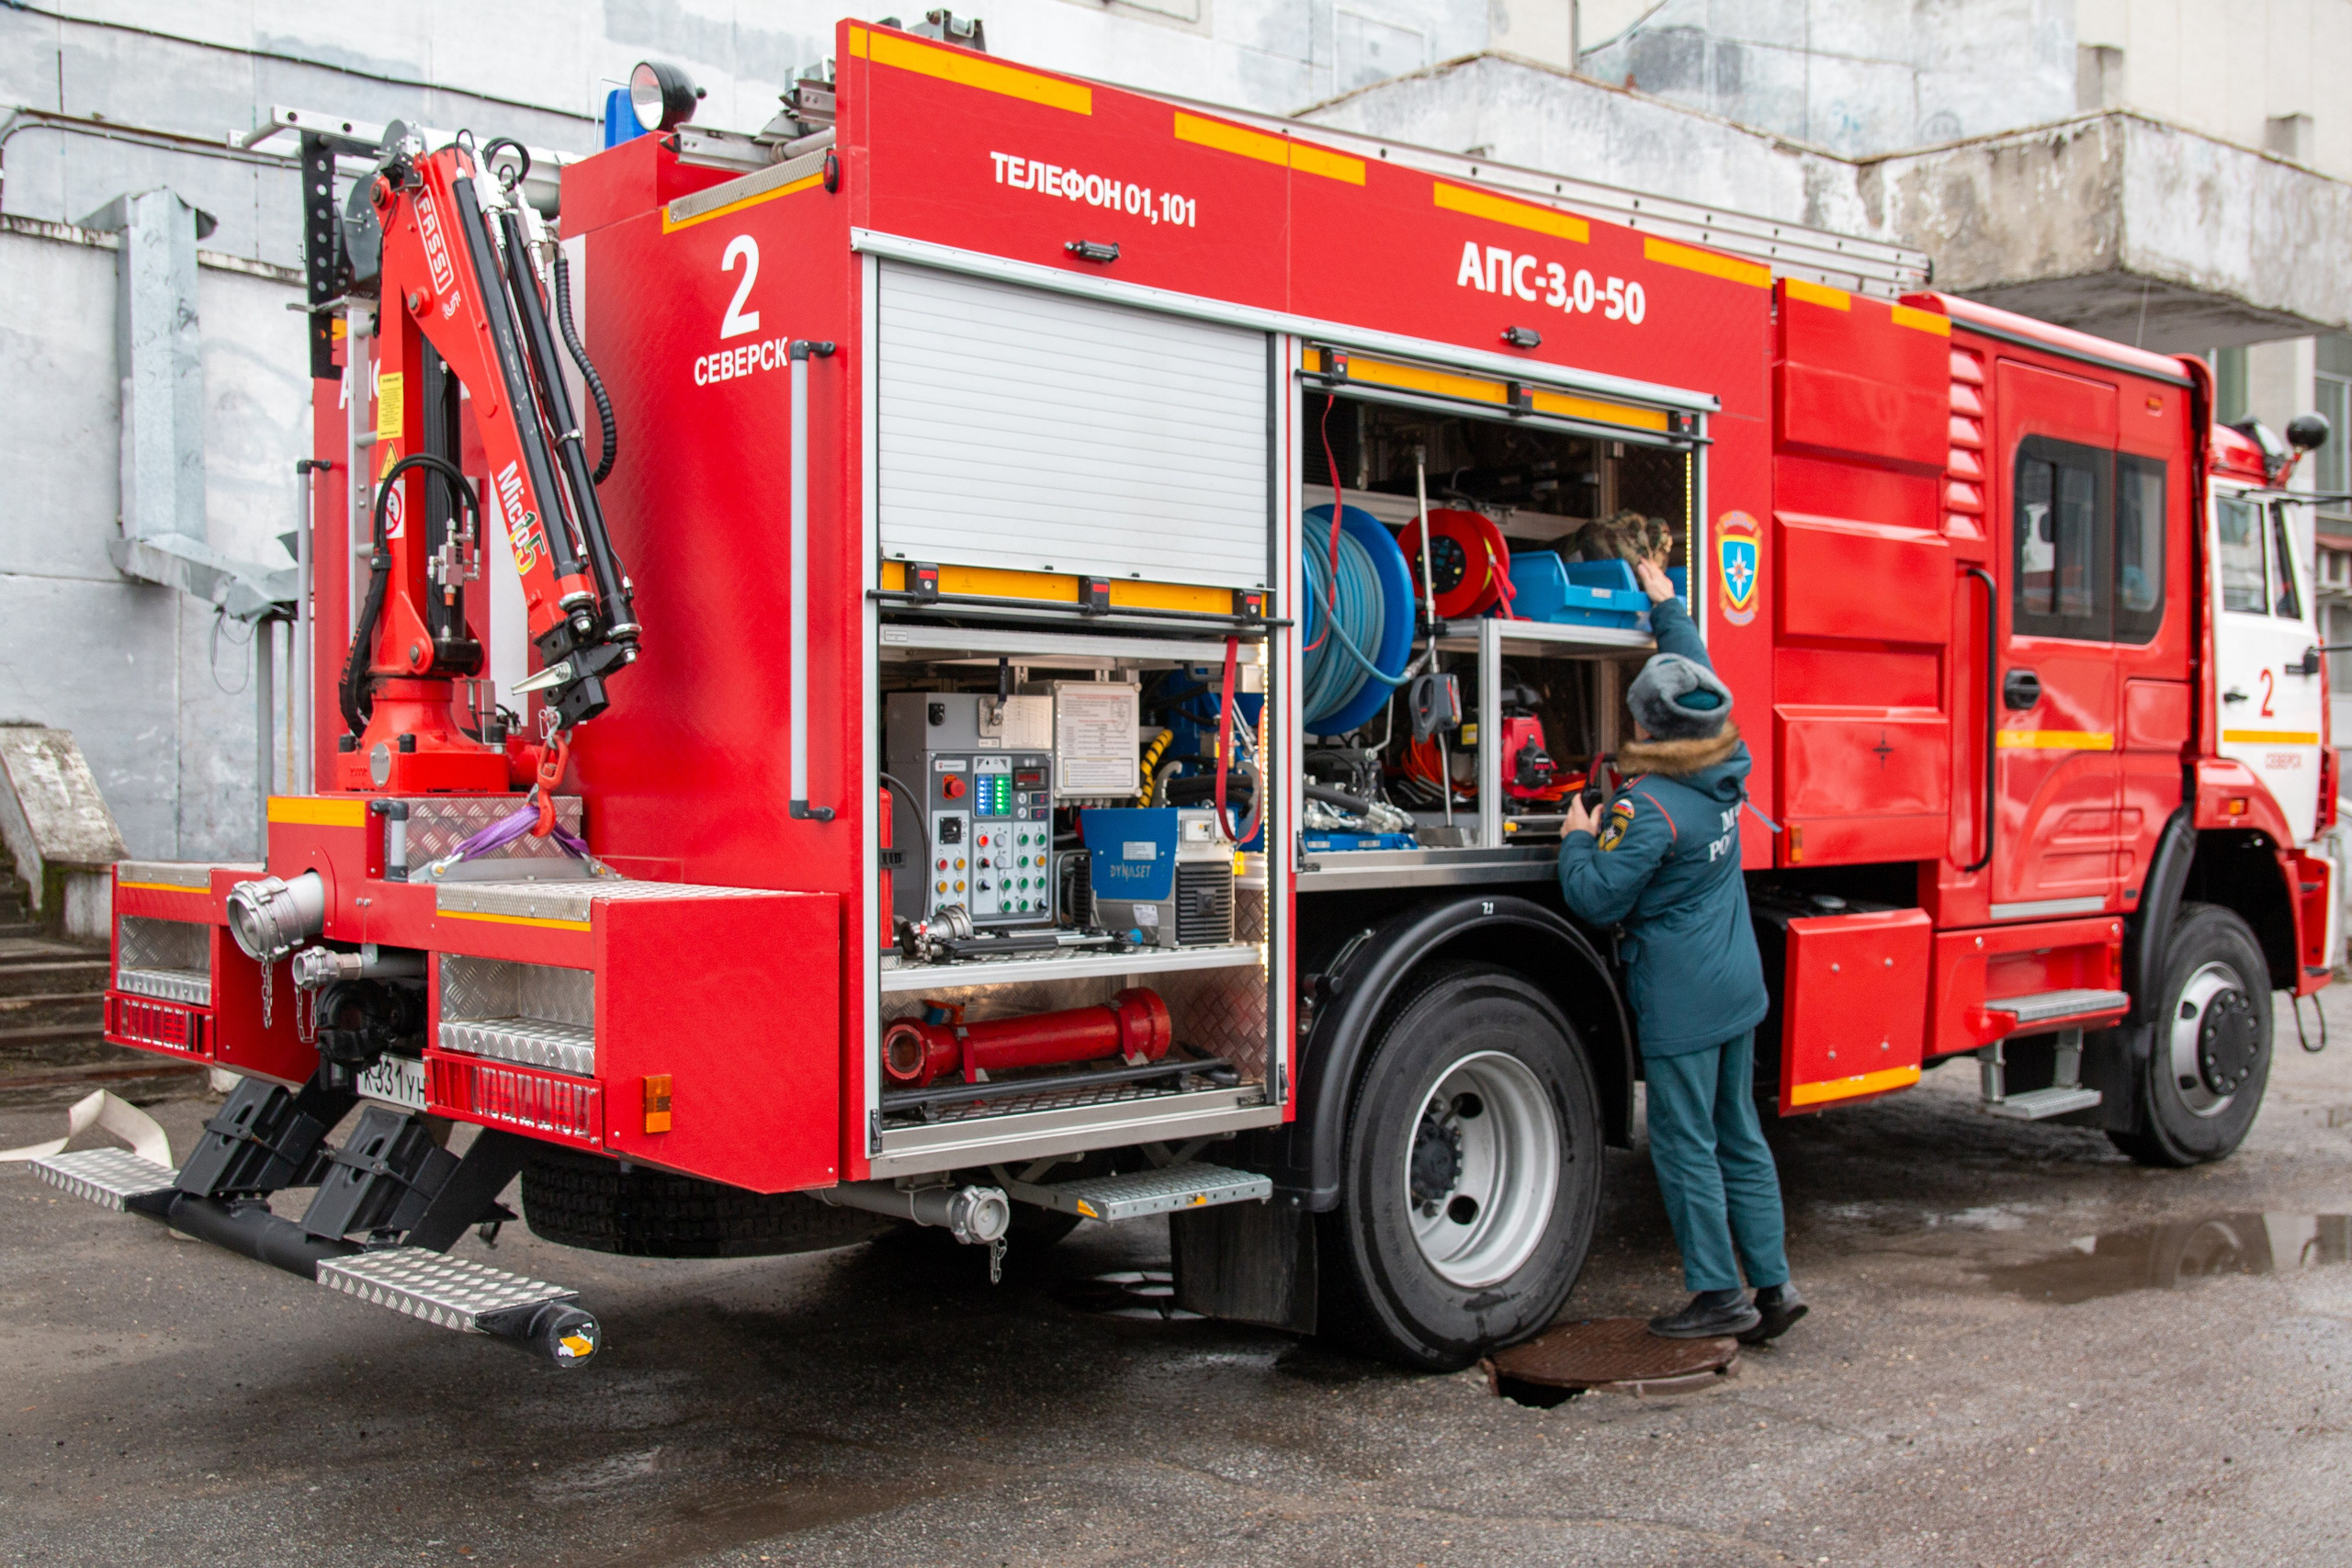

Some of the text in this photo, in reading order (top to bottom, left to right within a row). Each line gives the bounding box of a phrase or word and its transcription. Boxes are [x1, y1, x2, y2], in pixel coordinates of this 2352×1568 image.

[989, 151, 1196, 228] ТЕЛЕФОН 01,101
[418, 197, 449, 284] FASSI
[720, 234, 760, 340] 2
[1456, 241, 1646, 325] АПС-3,0-50
[694, 336, 788, 387] СЕВЕРСК
[497, 460, 530, 549] Micro
[2259, 669, 2274, 717] 2
[1110, 863, 1151, 880] DYNASET
